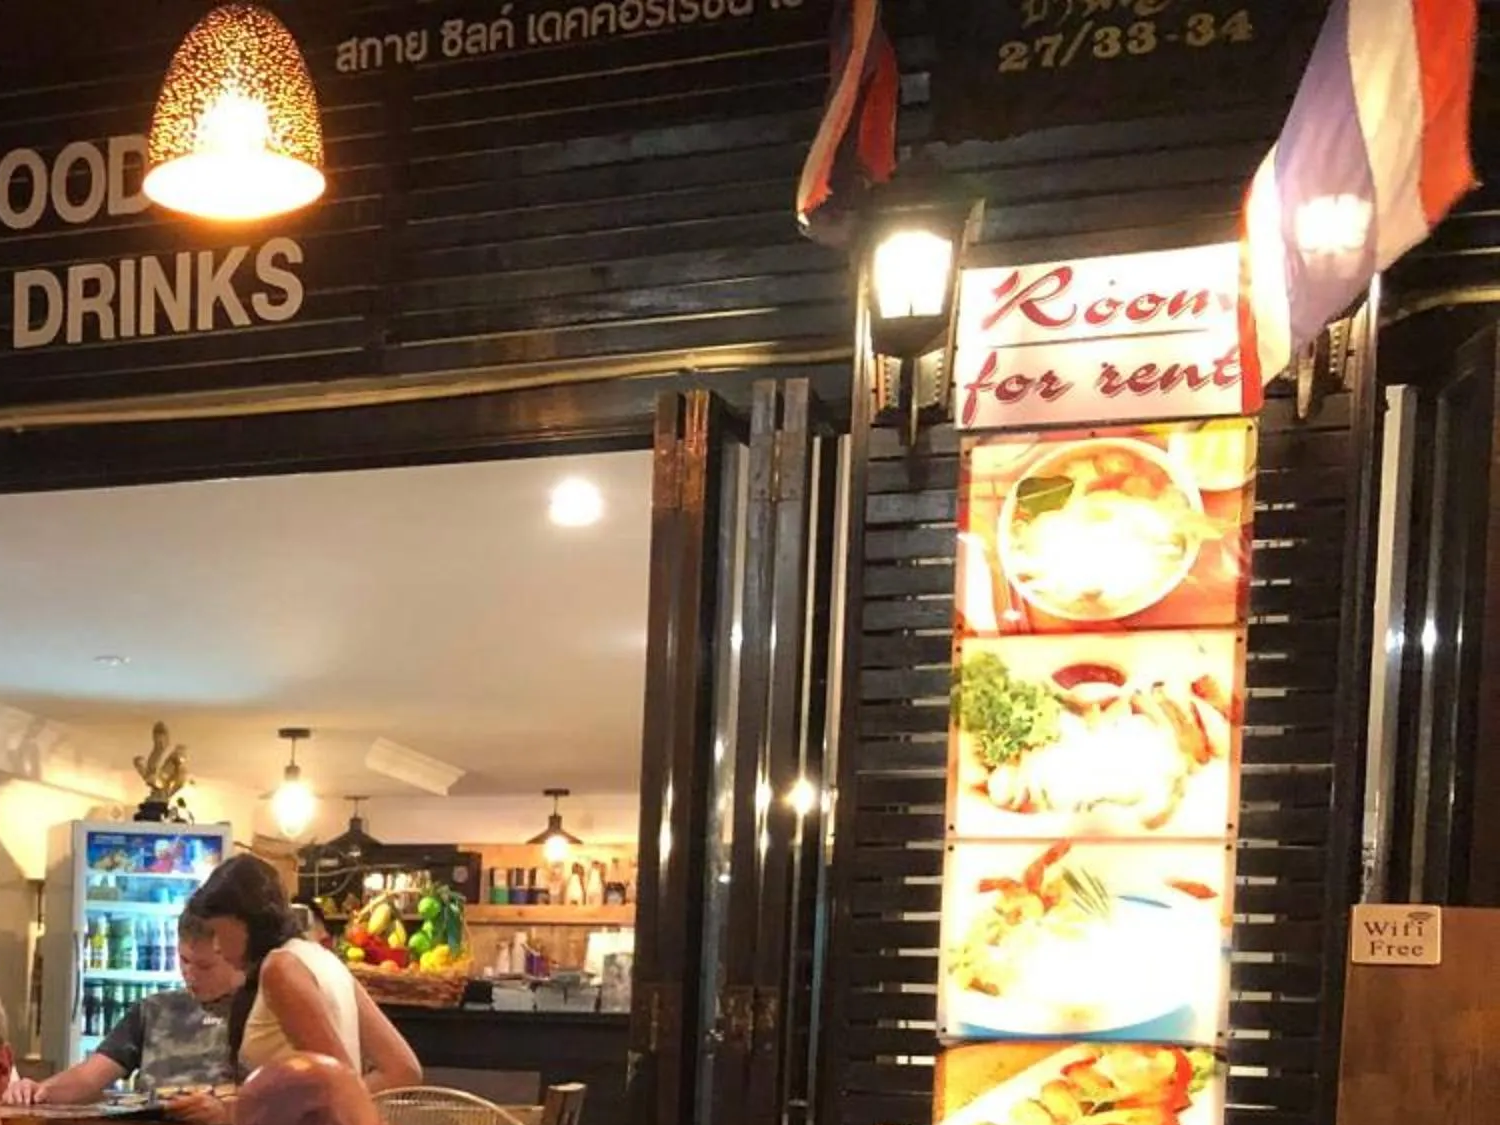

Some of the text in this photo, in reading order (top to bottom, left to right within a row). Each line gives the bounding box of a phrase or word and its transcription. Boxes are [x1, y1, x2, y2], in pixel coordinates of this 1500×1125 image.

[335, 34, 428, 72] สกาย
[998, 10, 1252, 72] 27/33-34
[13, 236, 303, 349] DRINKS
[961, 344, 1240, 428] for rent
[1369, 940, 1424, 957] Free
